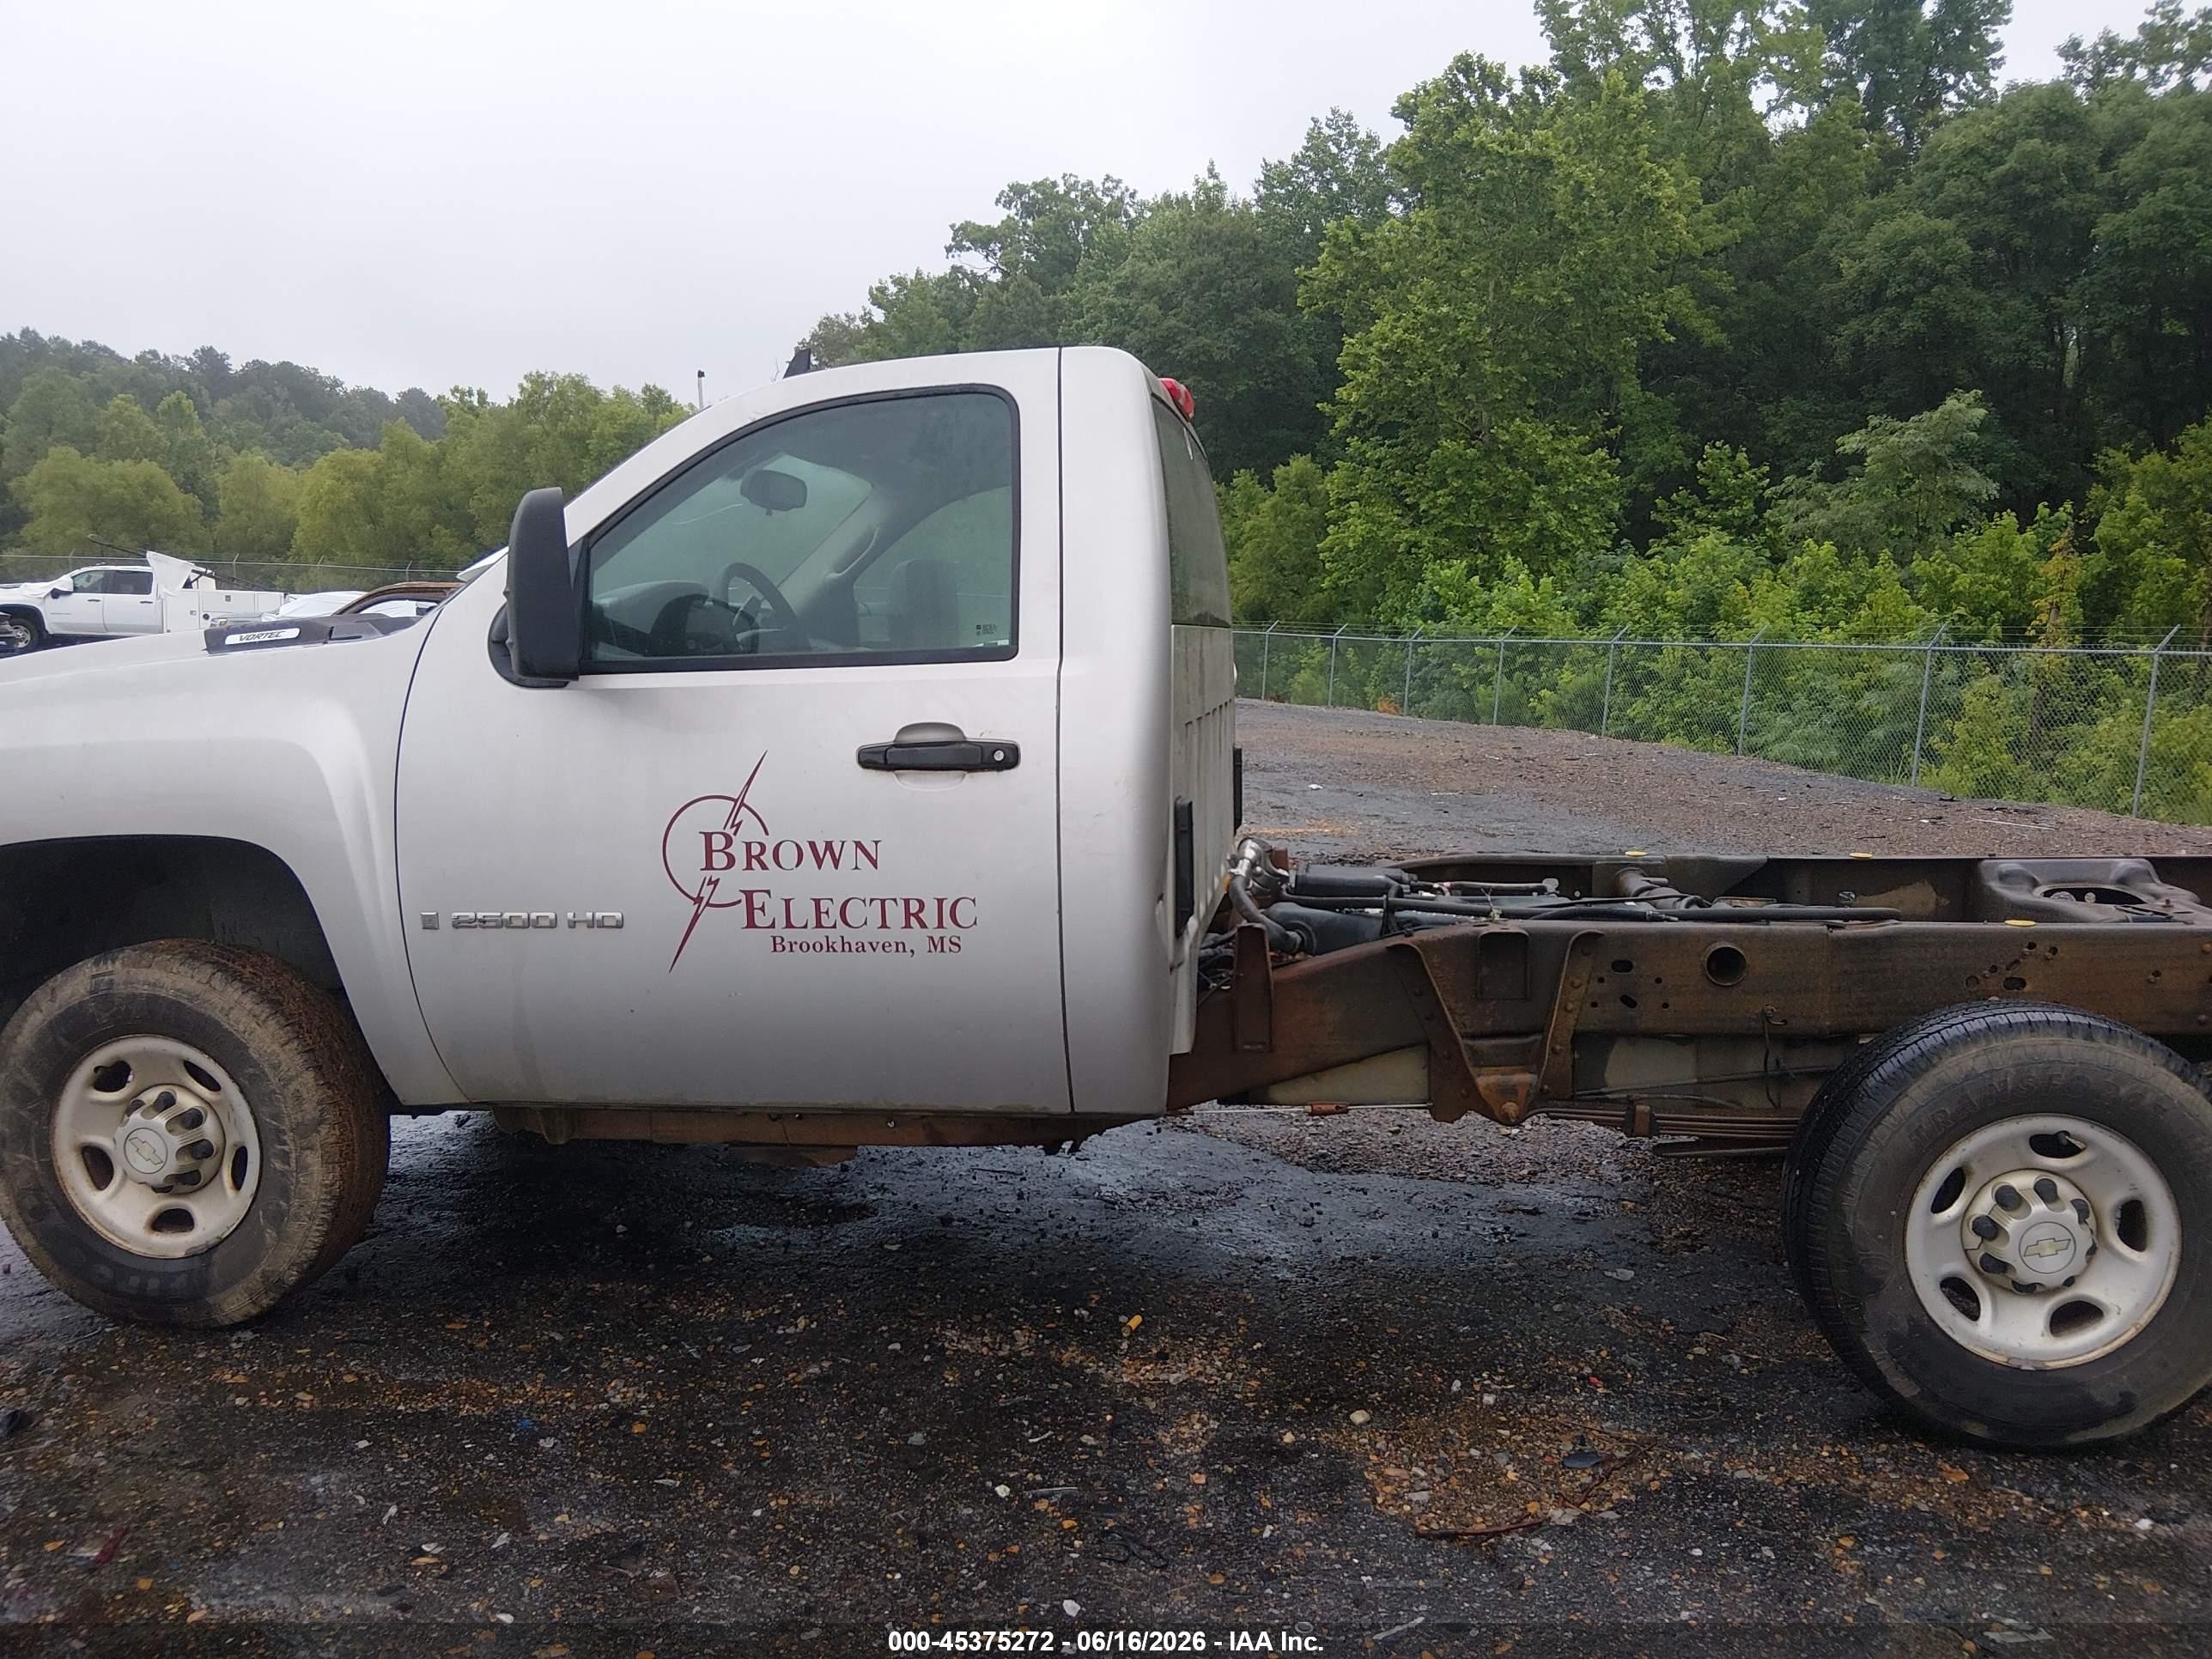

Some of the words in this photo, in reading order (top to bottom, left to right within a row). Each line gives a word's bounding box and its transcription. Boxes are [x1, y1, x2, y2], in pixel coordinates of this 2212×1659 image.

[239, 630, 286, 641] VORTEC
[698, 830, 882, 872] BROWN
[451, 912, 557, 929] 2500
[567, 912, 624, 929] HD
[738, 888, 978, 930] ELECTRIC
[770, 934, 916, 957] Brookhaven,
[927, 934, 963, 954] MS
